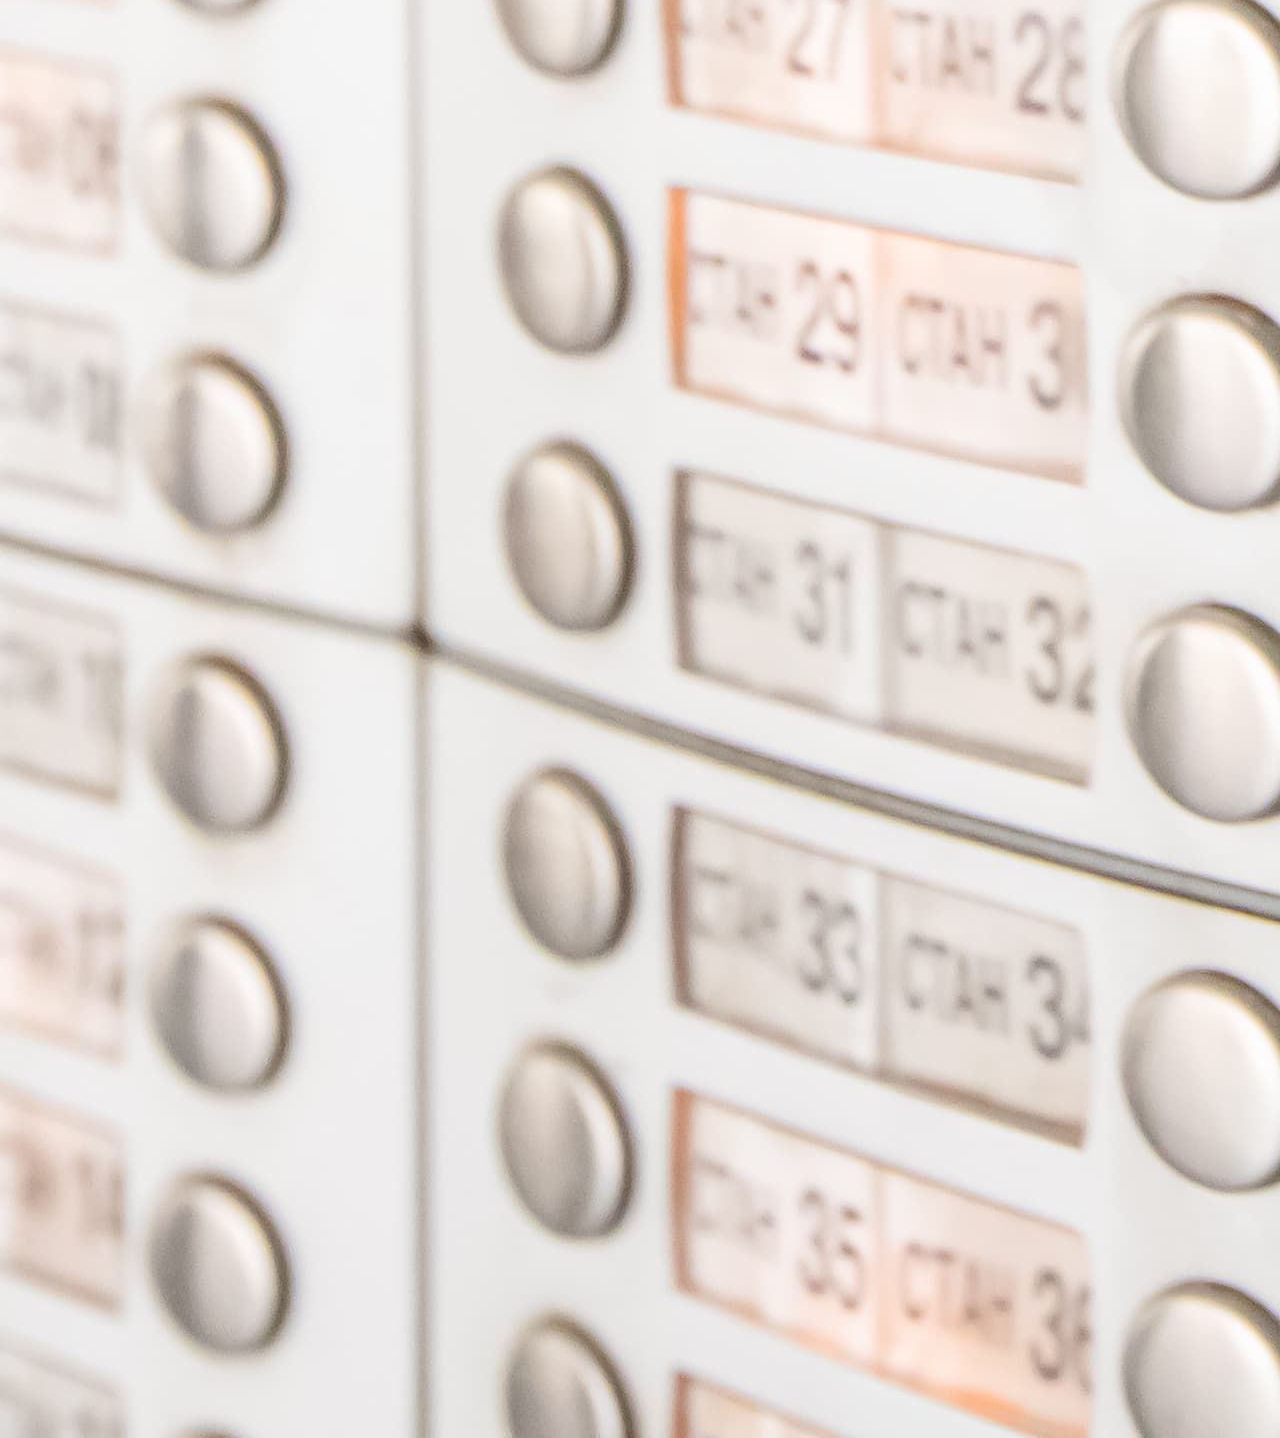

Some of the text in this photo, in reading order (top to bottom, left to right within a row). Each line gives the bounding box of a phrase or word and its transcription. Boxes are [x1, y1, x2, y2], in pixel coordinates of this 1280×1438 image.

[793, 259, 861, 375] 29
[793, 541, 851, 655] 31
[799, 888, 862, 1008] 33
